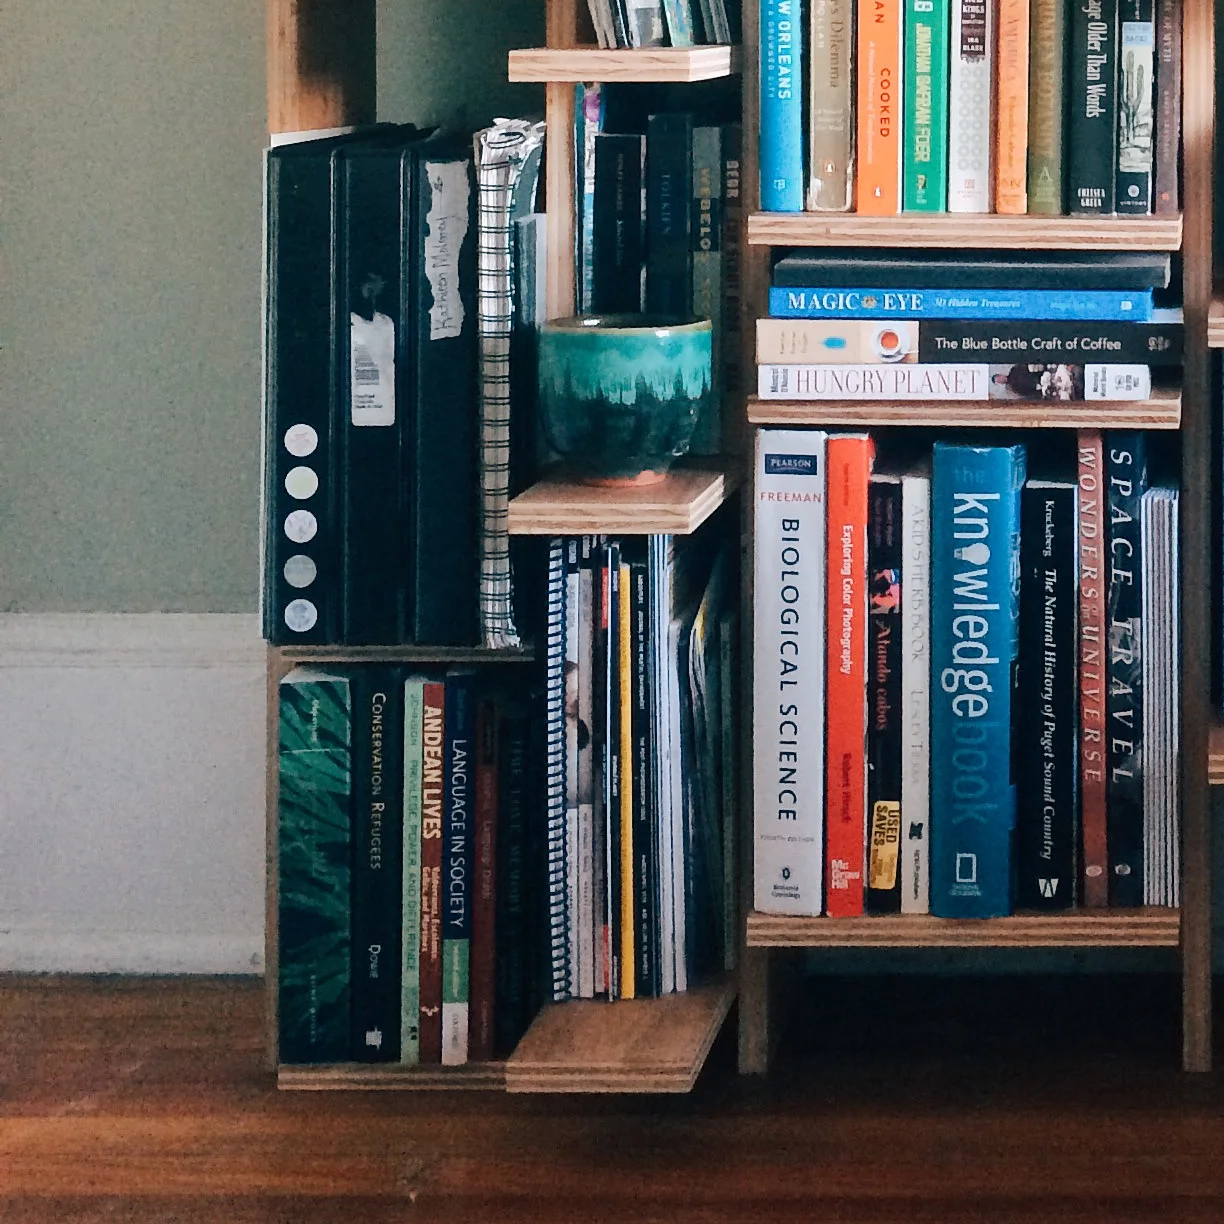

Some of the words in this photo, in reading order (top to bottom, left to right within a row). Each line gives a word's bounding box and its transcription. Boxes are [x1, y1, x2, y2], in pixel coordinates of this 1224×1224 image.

[777, 20, 791, 100] ORLEANS
[829, 20, 845, 88] Dilemma
[1086, 22, 1104, 51] Older
[1086, 54, 1102, 81] Than
[879, 68, 891, 138] COOKED
[1085, 84, 1102, 118] Words
[788, 292, 861, 311] MAGIC
[882, 293, 924, 311] EYE
[934, 337, 958, 350] The
[961, 337, 988, 350] Blue
[991, 337, 1028, 350] Bottle
[1031, 337, 1062, 350] Craft
[1065, 338, 1077, 350] of
[1079, 338, 1122, 351] Coffee
[795, 370, 889, 395] HUNGRY
[895, 369, 981, 394] PLANET
[771, 459, 811, 467] PEARSON
[760, 492, 822, 503] FREEMAN
[1109, 449, 1133, 587] SPACE
[1078, 446, 1101, 599] WONDERS
[839, 524, 854, 576] Exploring
[841, 578, 854, 606] Color
[1043, 568, 1057, 593] The
[779, 517, 800, 692] BIOLOGICAL
[1043, 595, 1057, 648] Natural
[839, 608, 854, 675] Photography
[1039, 650, 1057, 701] History
[875, 688, 892, 731] cabos
[1039, 705, 1057, 718] of
[1081, 625, 1101, 782] UNIVERSE
[1111, 618, 1135, 784] TRAVEL
[422, 705, 442, 783] ANDEAN
[1038, 720, 1056, 758] Puget
[449, 739, 467, 833] LANGUAGE
[778, 704, 799, 822] SCIENCE
[1042, 761, 1056, 803] Sound
[422, 788, 442, 839] LIVES
[872, 804, 888, 847] SAVES
[884, 805, 900, 844] USED
[1039, 805, 1055, 860] Country
[449, 836, 466, 854] IN
[407, 872, 417, 897] AND
[448, 857, 466, 928] SOCIETY
